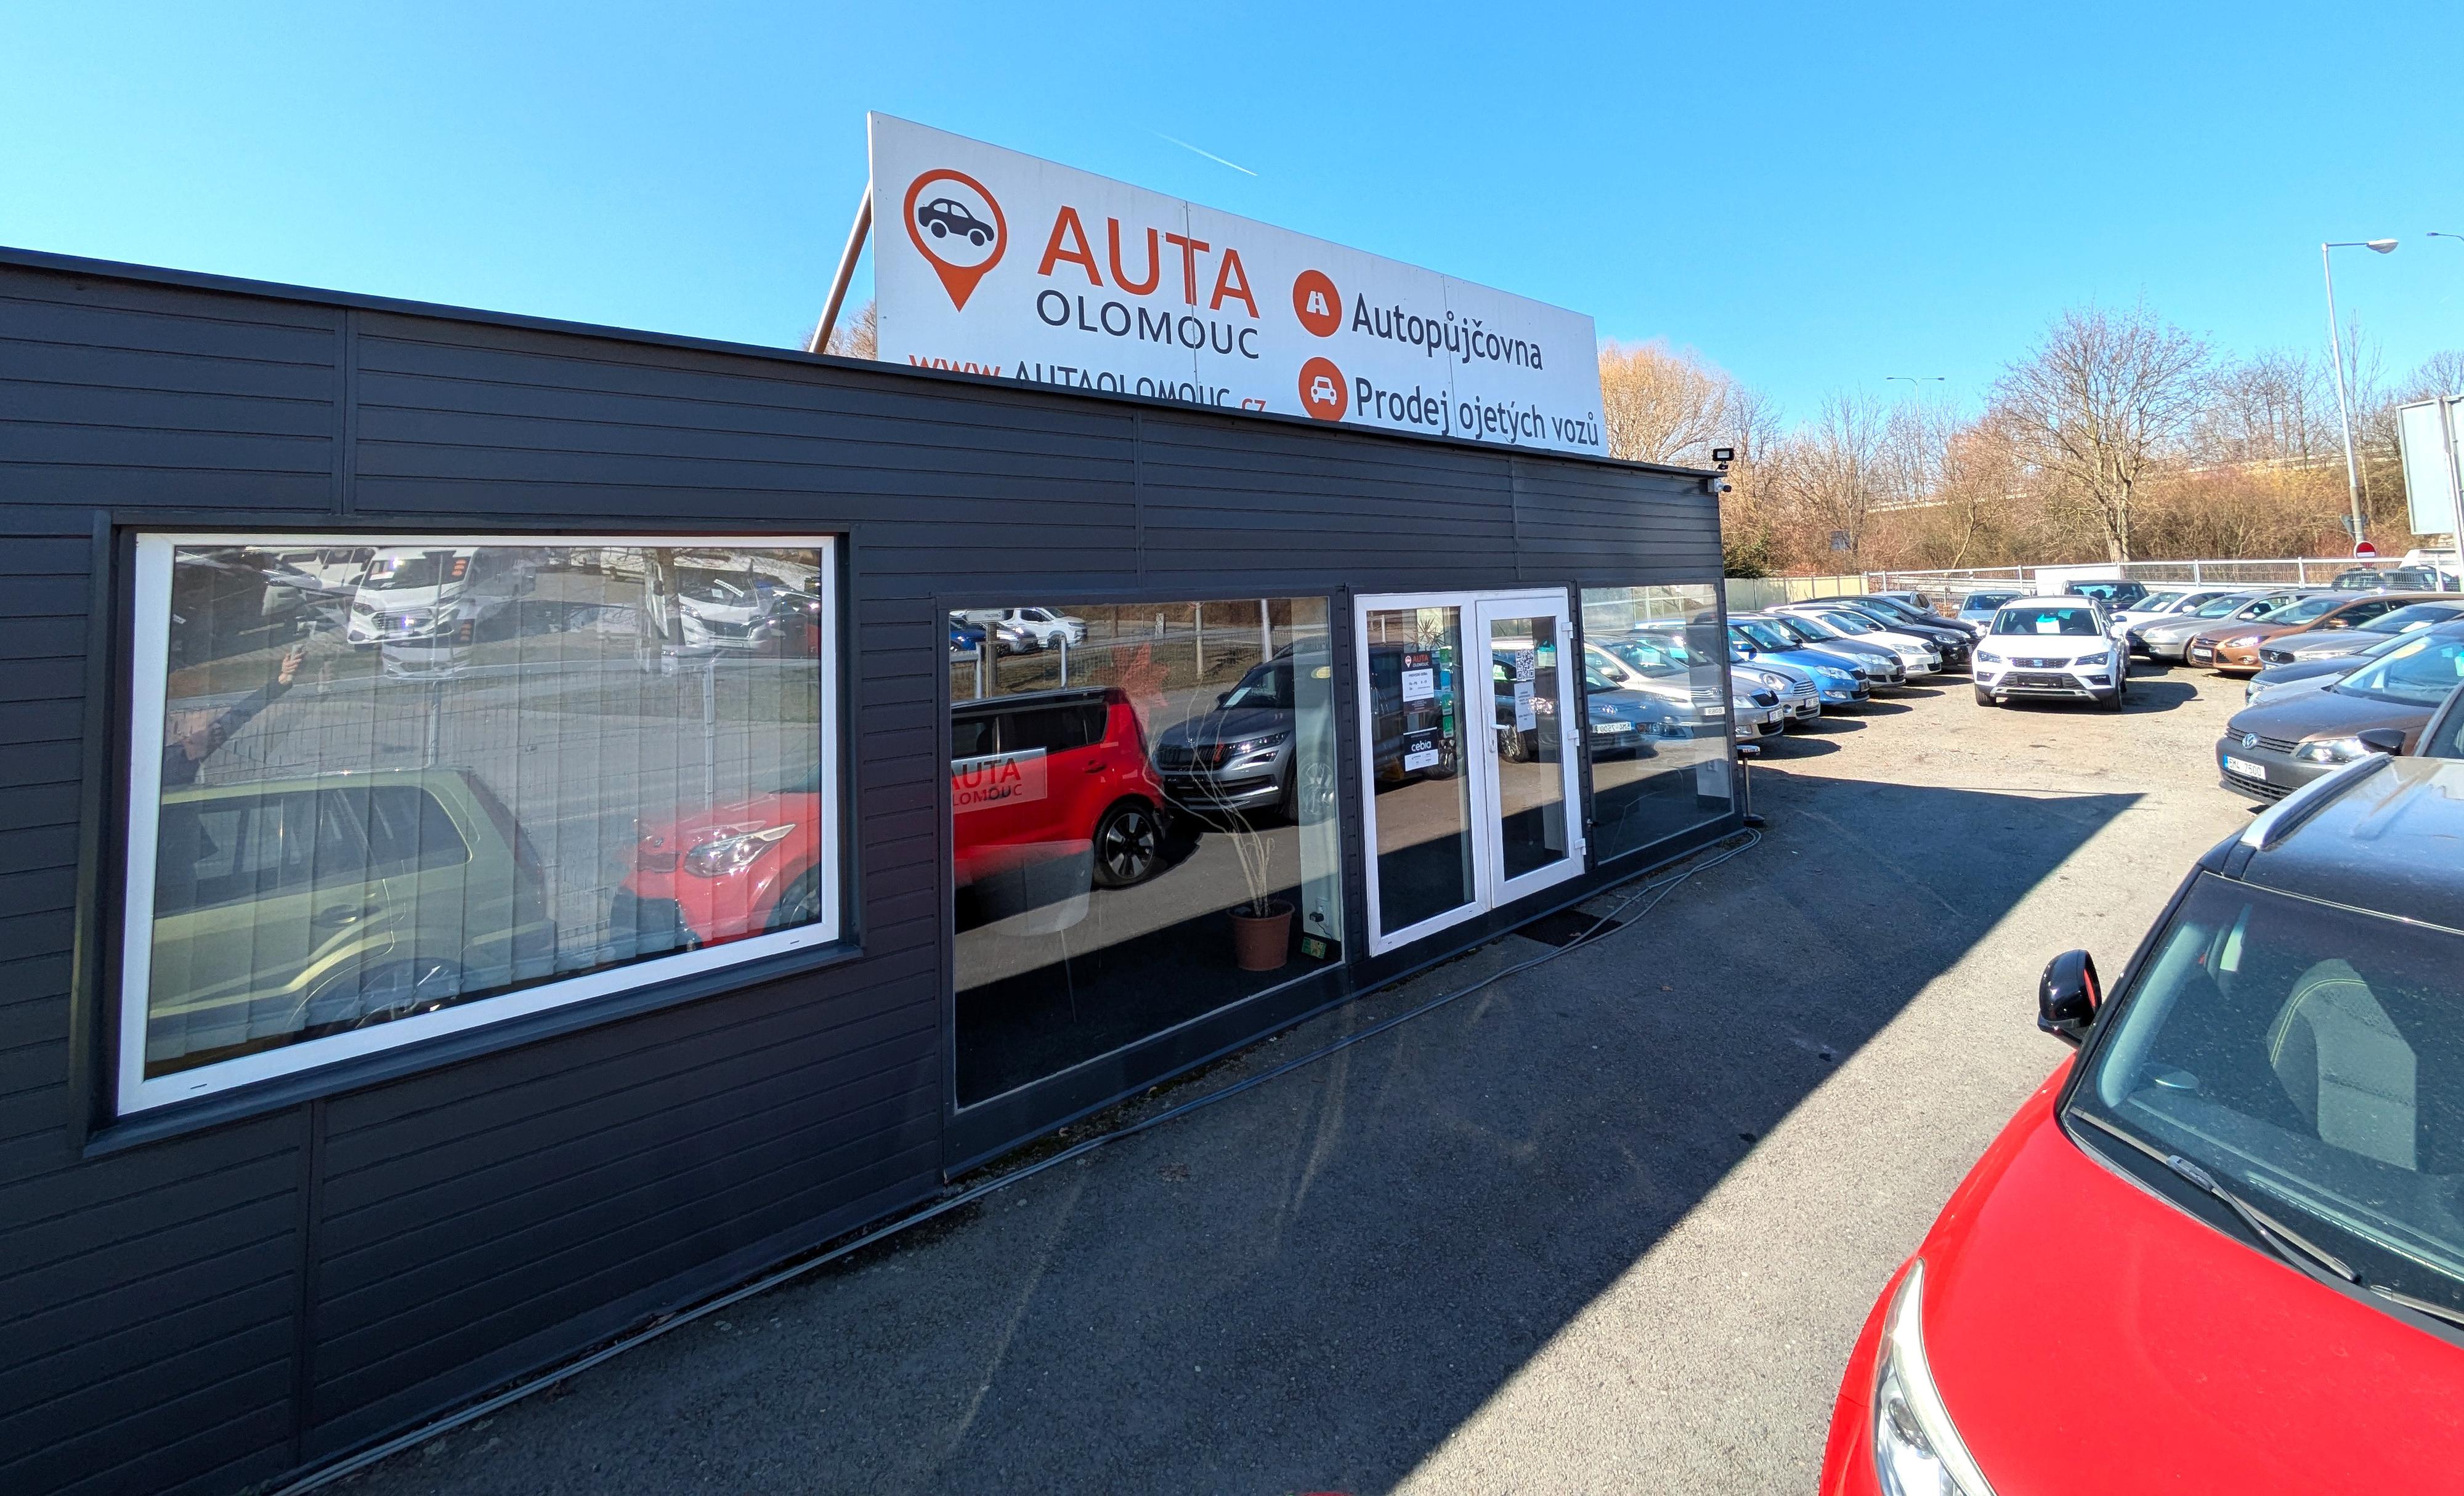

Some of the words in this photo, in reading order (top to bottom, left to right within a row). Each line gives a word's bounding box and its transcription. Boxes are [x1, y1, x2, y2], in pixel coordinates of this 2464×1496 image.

[1037, 205, 1260, 319] AUTA
[1036, 289, 1259, 360] OLOMOUC
[1352, 292, 1542, 370] Autopůjčovna
[1355, 377, 1448, 437] Prodej
[1459, 395, 1546, 444] ojetých
[1551, 411, 1599, 447] vozů
[1413, 655, 1429, 663] AUTA
[1411, 740, 1432, 751] cebia
[952, 784, 1022, 807] LOMOUC
